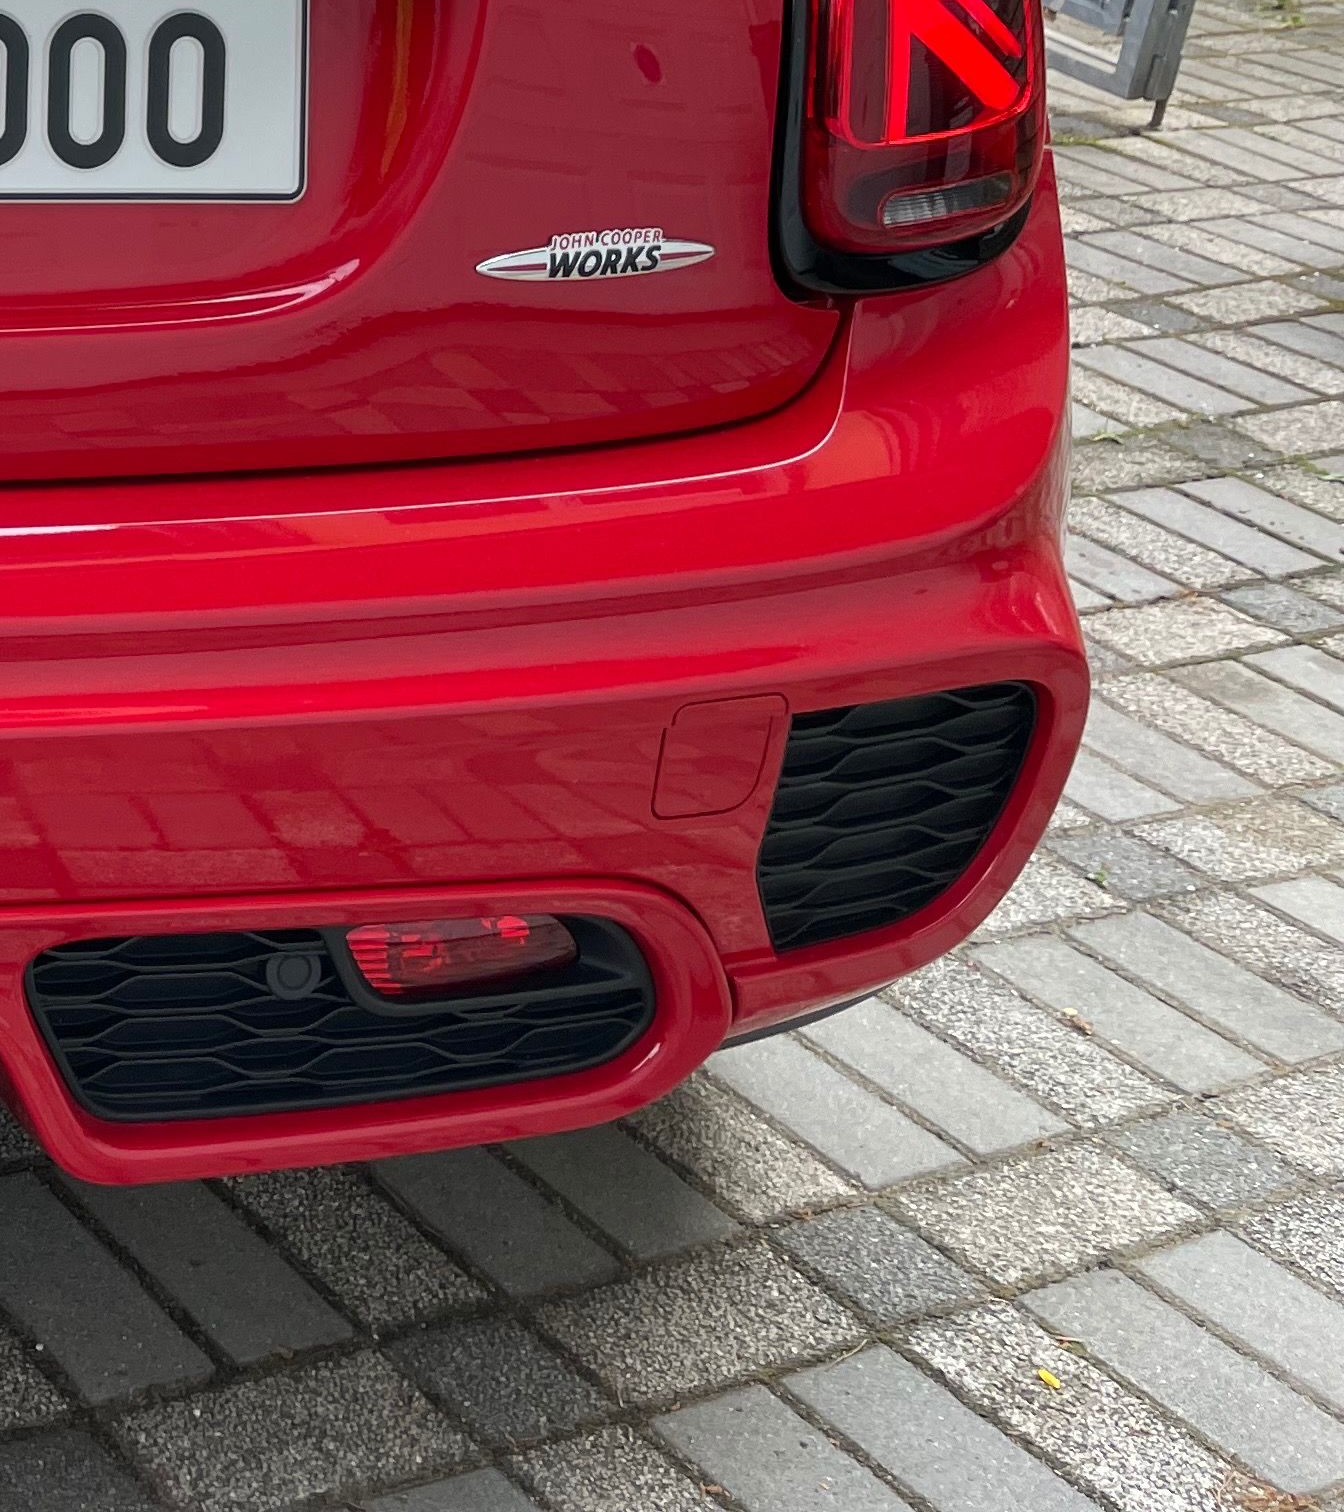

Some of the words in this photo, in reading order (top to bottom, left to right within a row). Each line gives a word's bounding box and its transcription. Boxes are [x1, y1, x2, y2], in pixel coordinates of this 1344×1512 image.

[550, 232, 596, 251] JOHN
[600, 229, 662, 246] COOPER
[547, 245, 662, 279] WORKS
